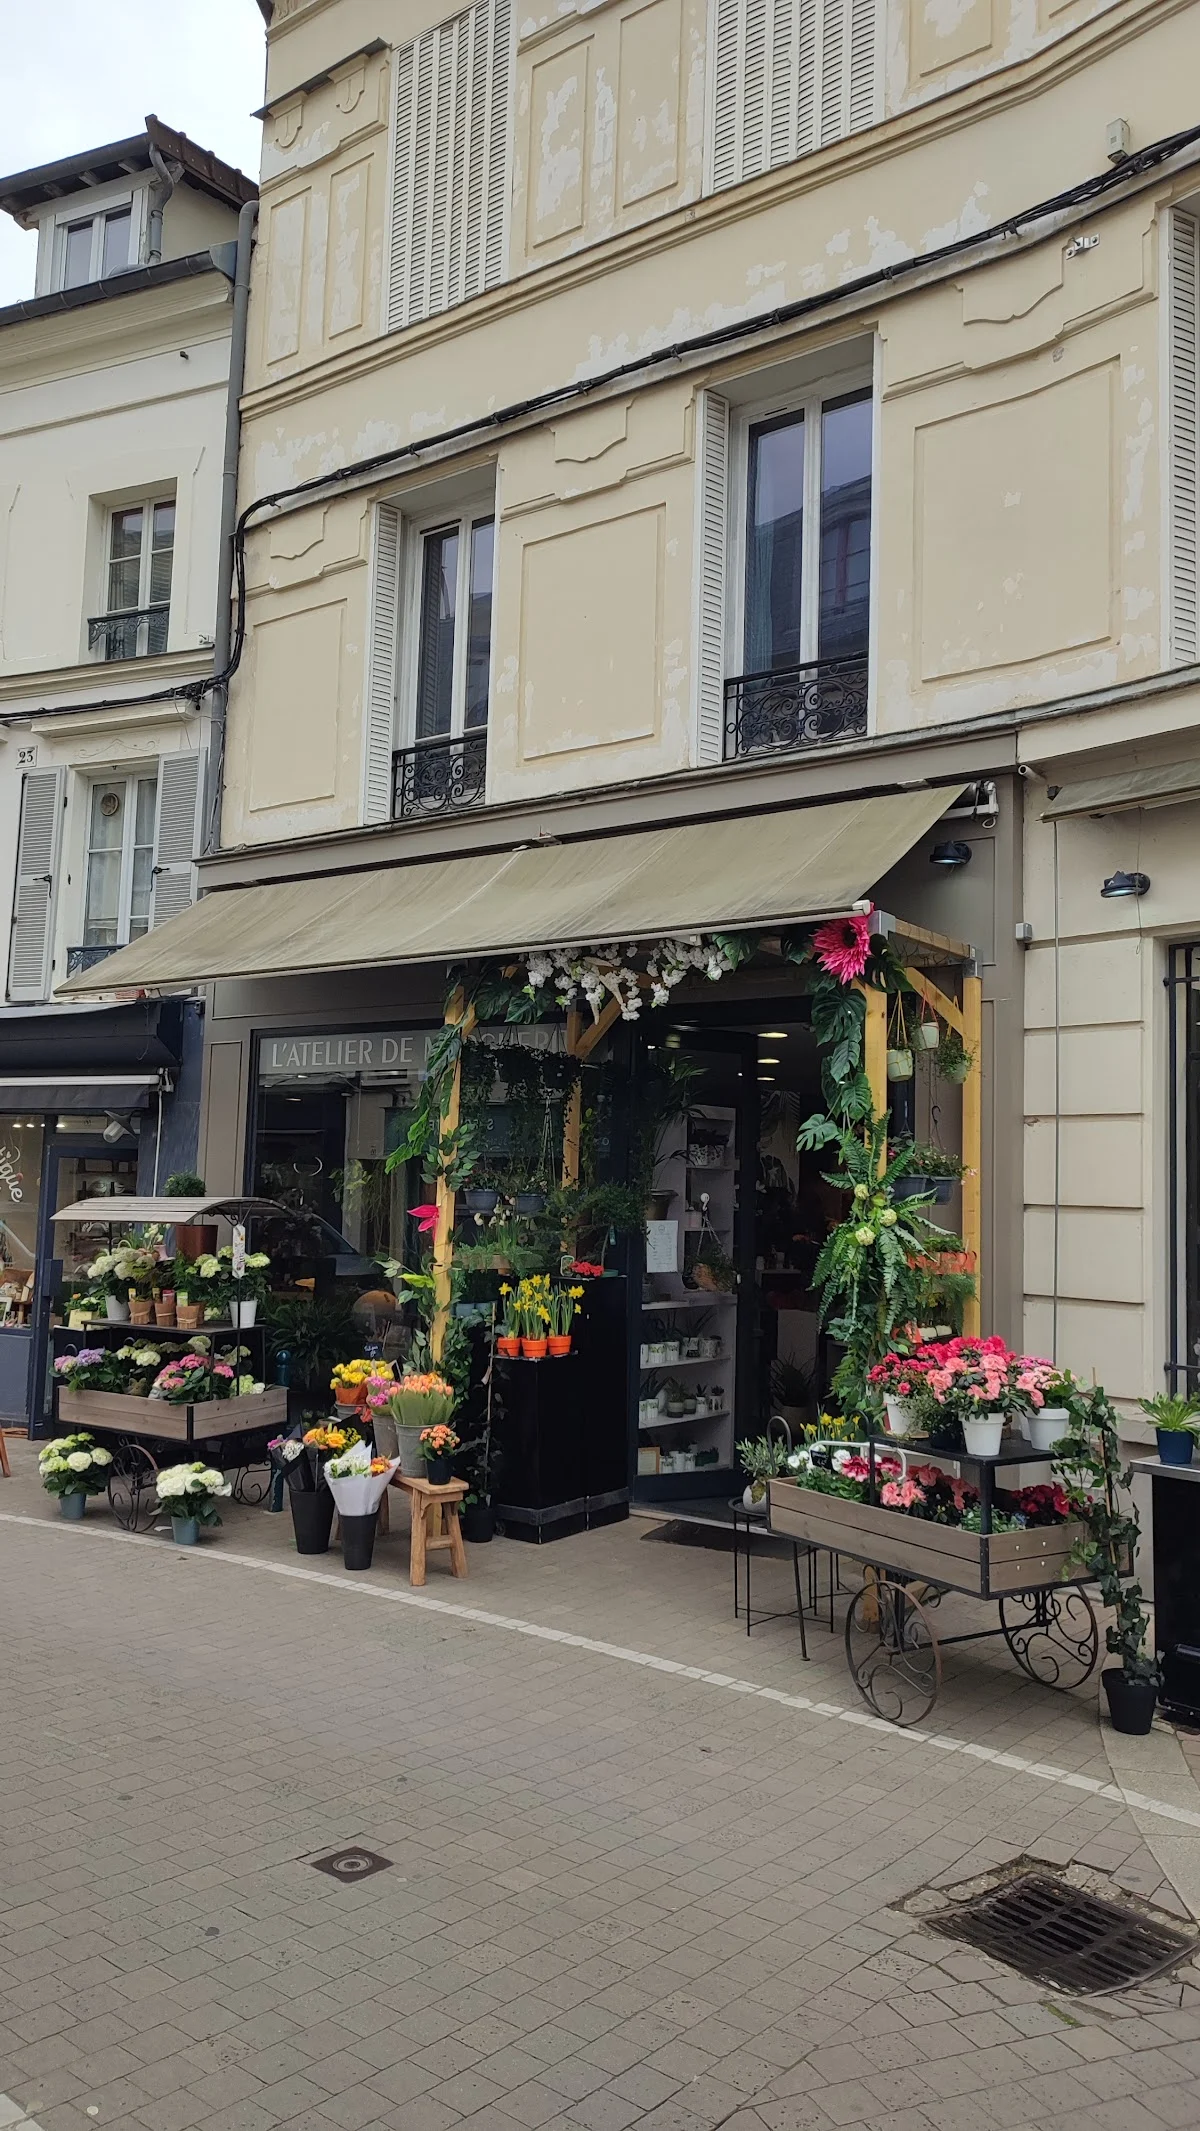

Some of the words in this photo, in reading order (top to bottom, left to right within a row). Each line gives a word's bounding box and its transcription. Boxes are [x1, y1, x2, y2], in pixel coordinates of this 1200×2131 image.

[19, 749, 34, 764] 23
[272, 1038, 373, 1067] L'ATELIER
[381, 1036, 412, 1064] DE
